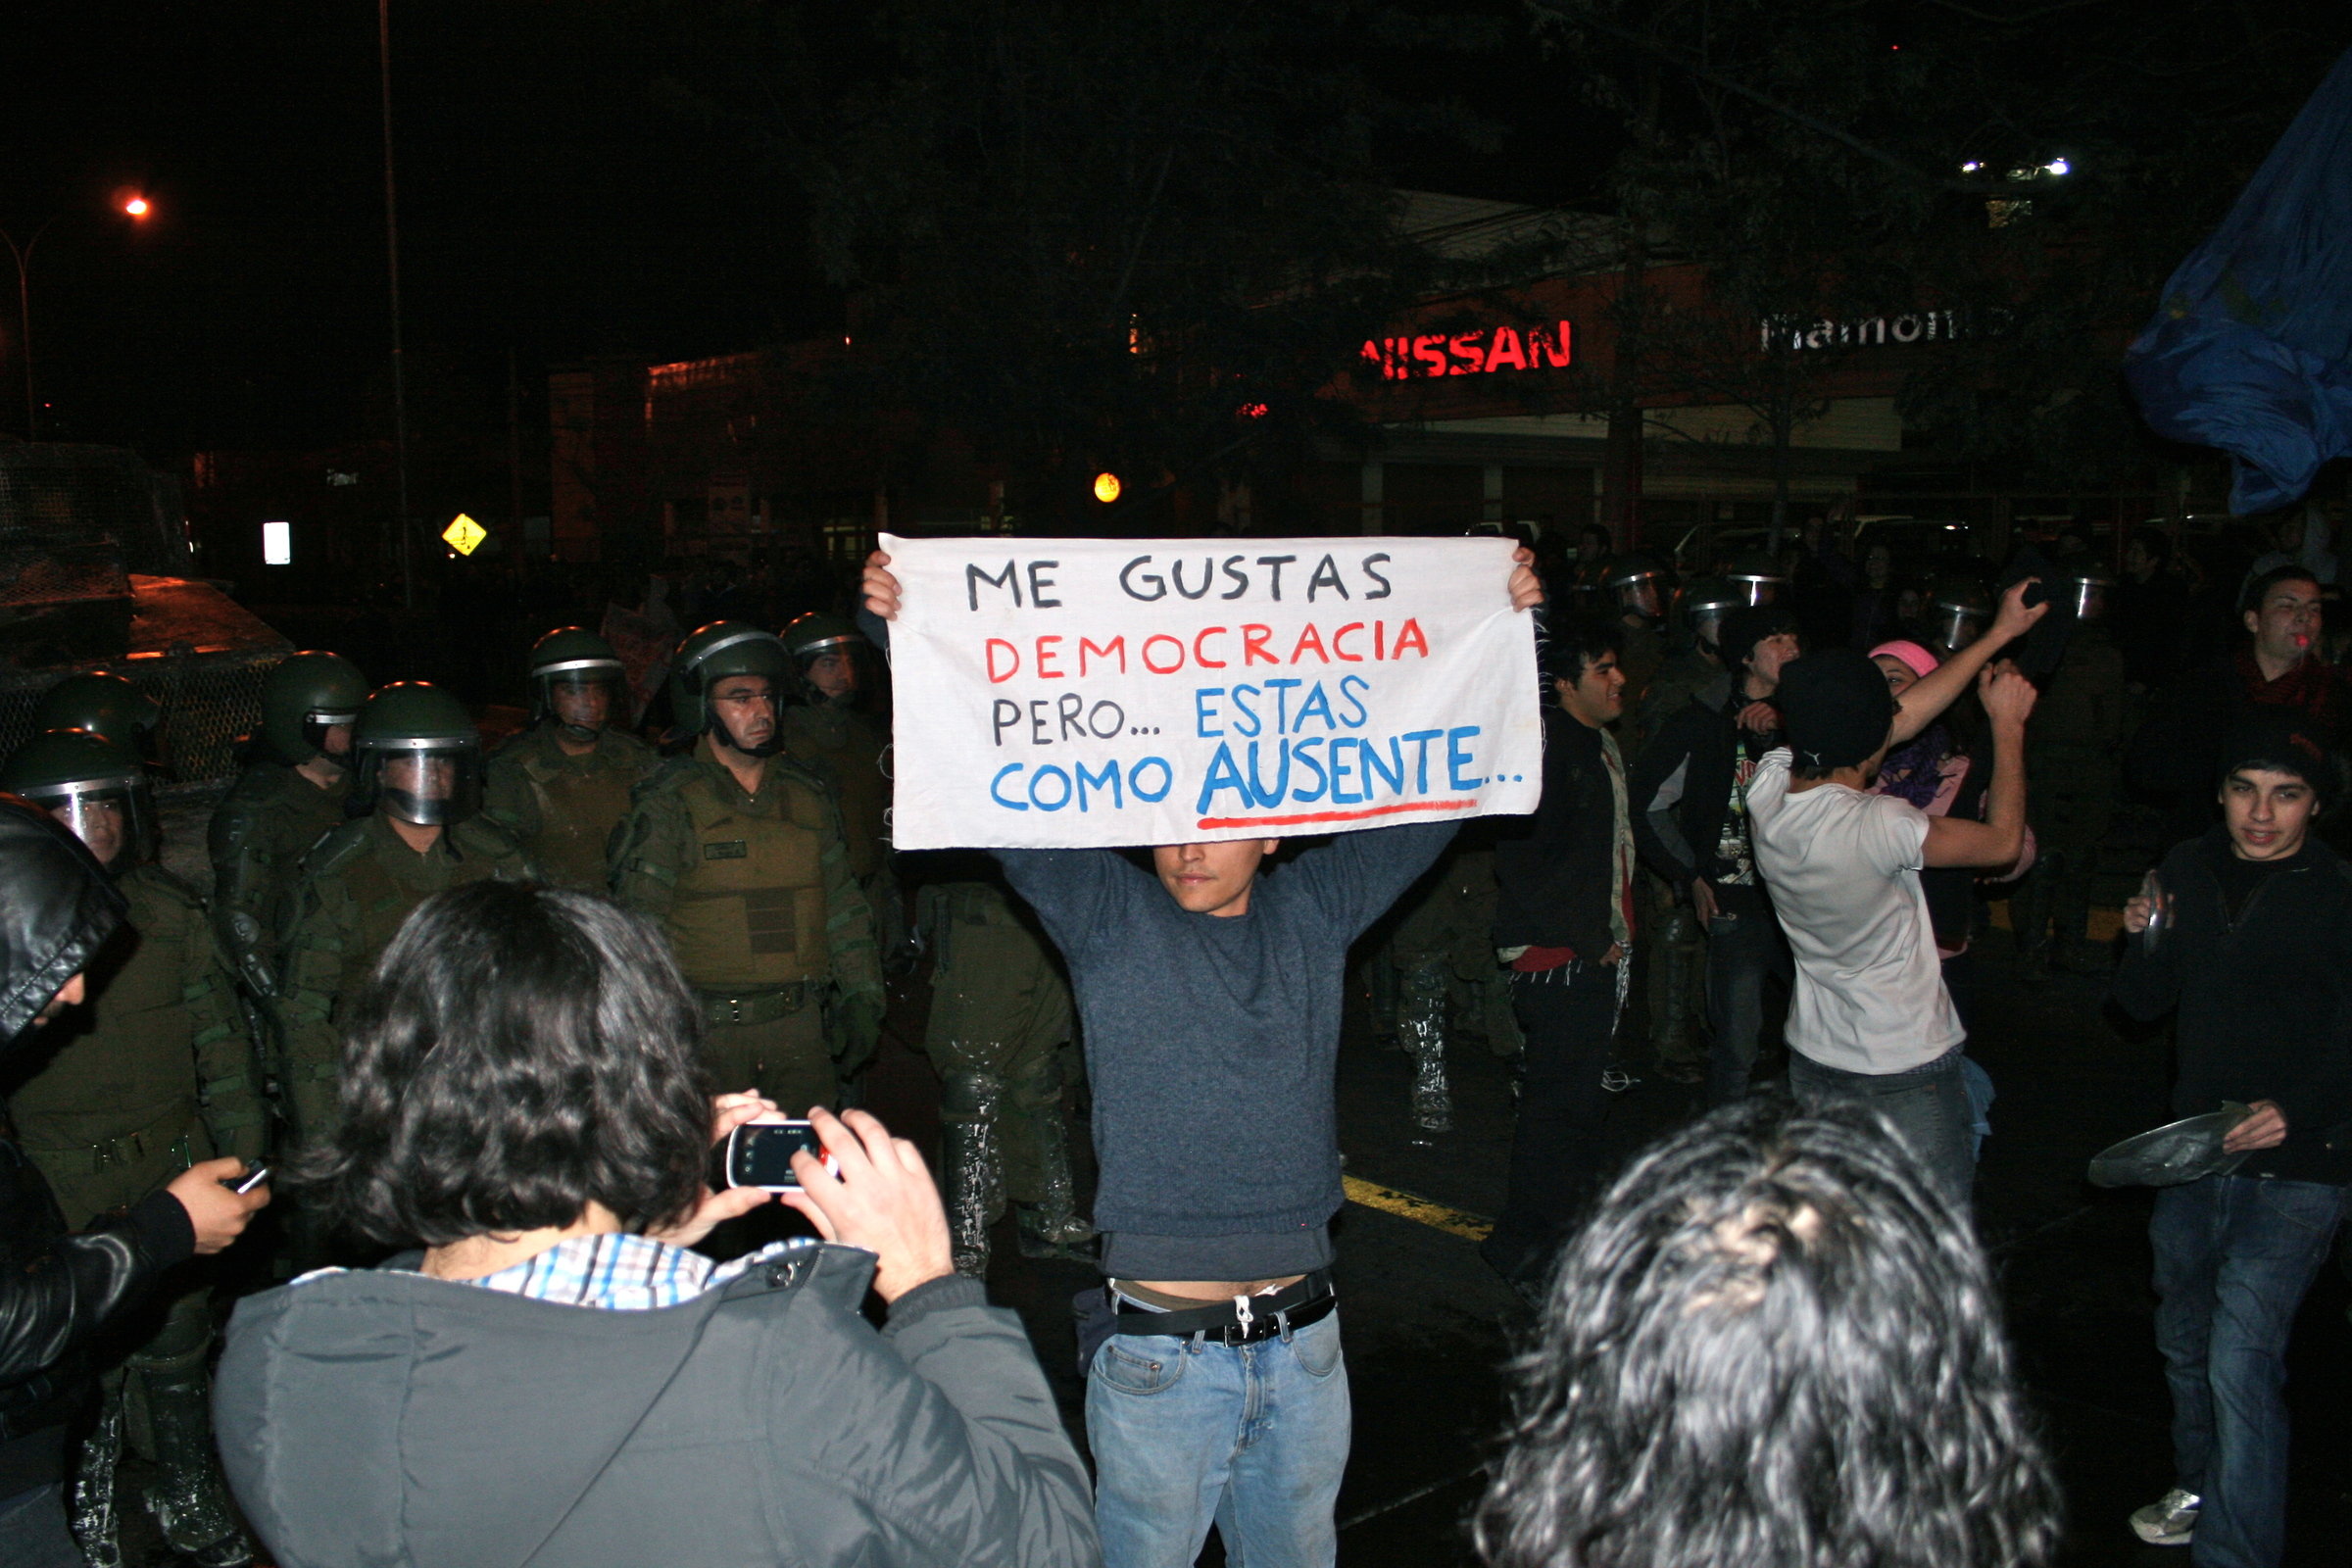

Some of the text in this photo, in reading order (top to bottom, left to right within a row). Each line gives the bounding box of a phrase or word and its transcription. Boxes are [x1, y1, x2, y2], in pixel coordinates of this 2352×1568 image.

[965, 553, 1393, 612] ME GUSTAS
[985, 617, 1430, 684] DEMOCRACIA
[992, 674, 1370, 747] PERO... ESTAS
[990, 725, 1524, 815] COMO AUSENTE...
